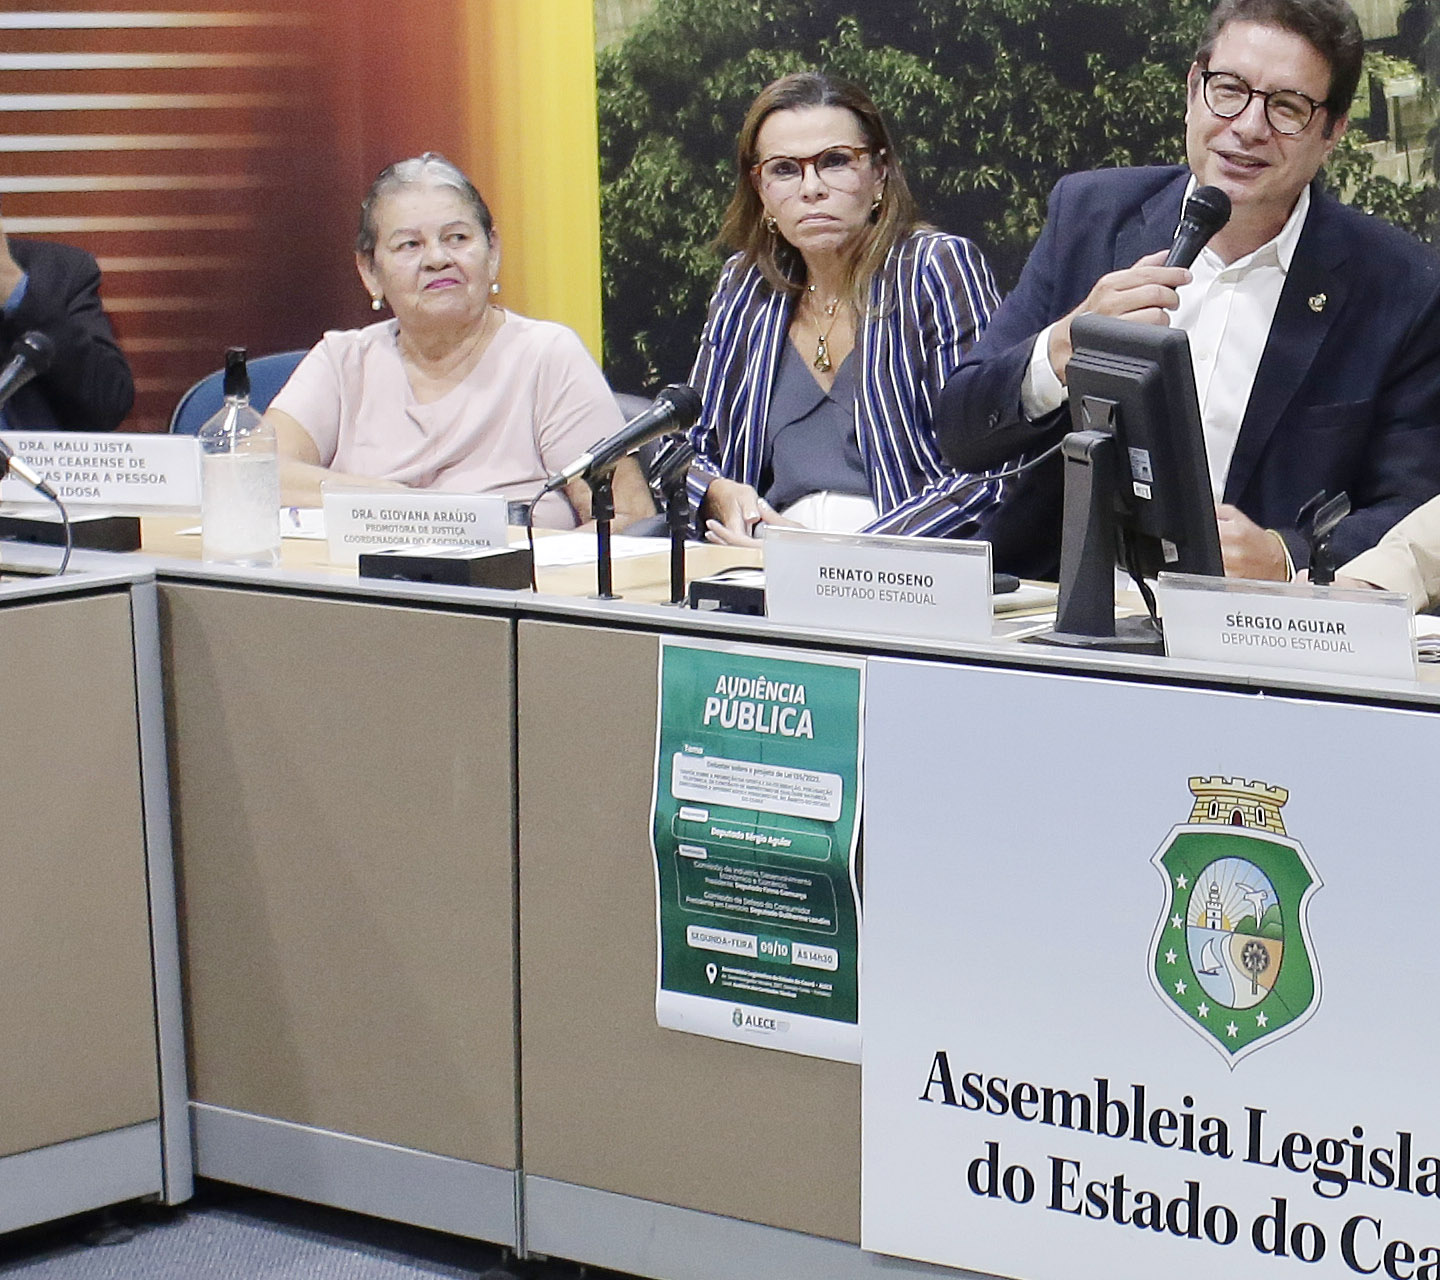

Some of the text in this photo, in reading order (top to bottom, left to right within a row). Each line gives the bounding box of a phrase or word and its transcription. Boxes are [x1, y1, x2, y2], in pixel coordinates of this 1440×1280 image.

[19, 441, 133, 453] DRA. MALU JUSTA
[59, 458, 124, 468] CEARENSE
[130, 459, 145, 468] DE
[65, 472, 97, 482] PARA
[104, 474, 112, 482] A
[117, 473, 167, 483] PESSOA
[60, 486, 100, 496] IDOSA
[352, 509, 476, 522] DRA. GIOVANA ARAÚJO
[344, 535, 410, 544] COORDENADORA
[366, 524, 415, 533] PROMOTORA
[432, 526, 465, 536] JUSTIÇA
[819, 567, 933, 588] RENATO ROSENO
[816, 584, 936, 605] DEPUTADO ESTADUAL
[1226, 612, 1346, 635] SÉRGIO AGUIAR
[1222, 633, 1355, 653] DEPUTADO ESTADUAL
[715, 675, 806, 704] AUDIÊNCIA
[704, 692, 814, 739] PÚBLICA
[711, 827, 791, 849] Deputado Sérgio Aguiar
[745, 1015, 776, 1030] ALECE
[918, 1050, 1232, 1159] Assembleia
[967, 1141, 1034, 1204] do
[1046, 1156, 1238, 1245] Estado
[1251, 1197, 1325, 1263] do
